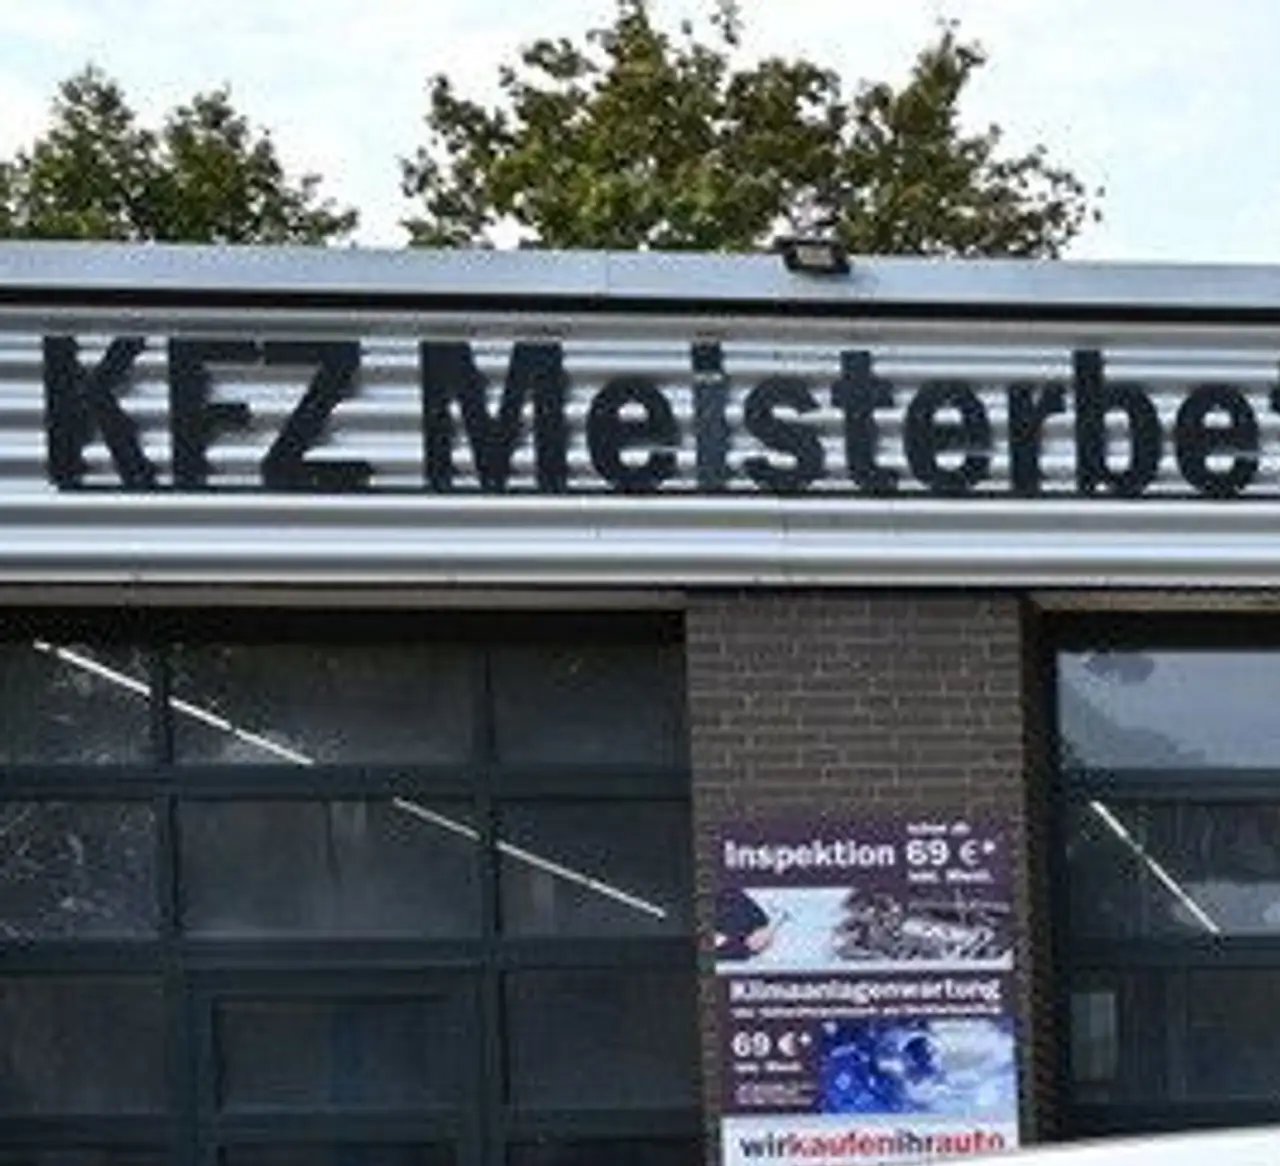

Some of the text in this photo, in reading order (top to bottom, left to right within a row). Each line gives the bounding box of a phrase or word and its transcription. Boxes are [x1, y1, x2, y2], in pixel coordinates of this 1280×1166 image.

[42, 336, 372, 491] KFZ
[724, 838, 895, 875] Inspektion
[906, 839, 950, 867] 69
[731, 1031, 771, 1057] 69
